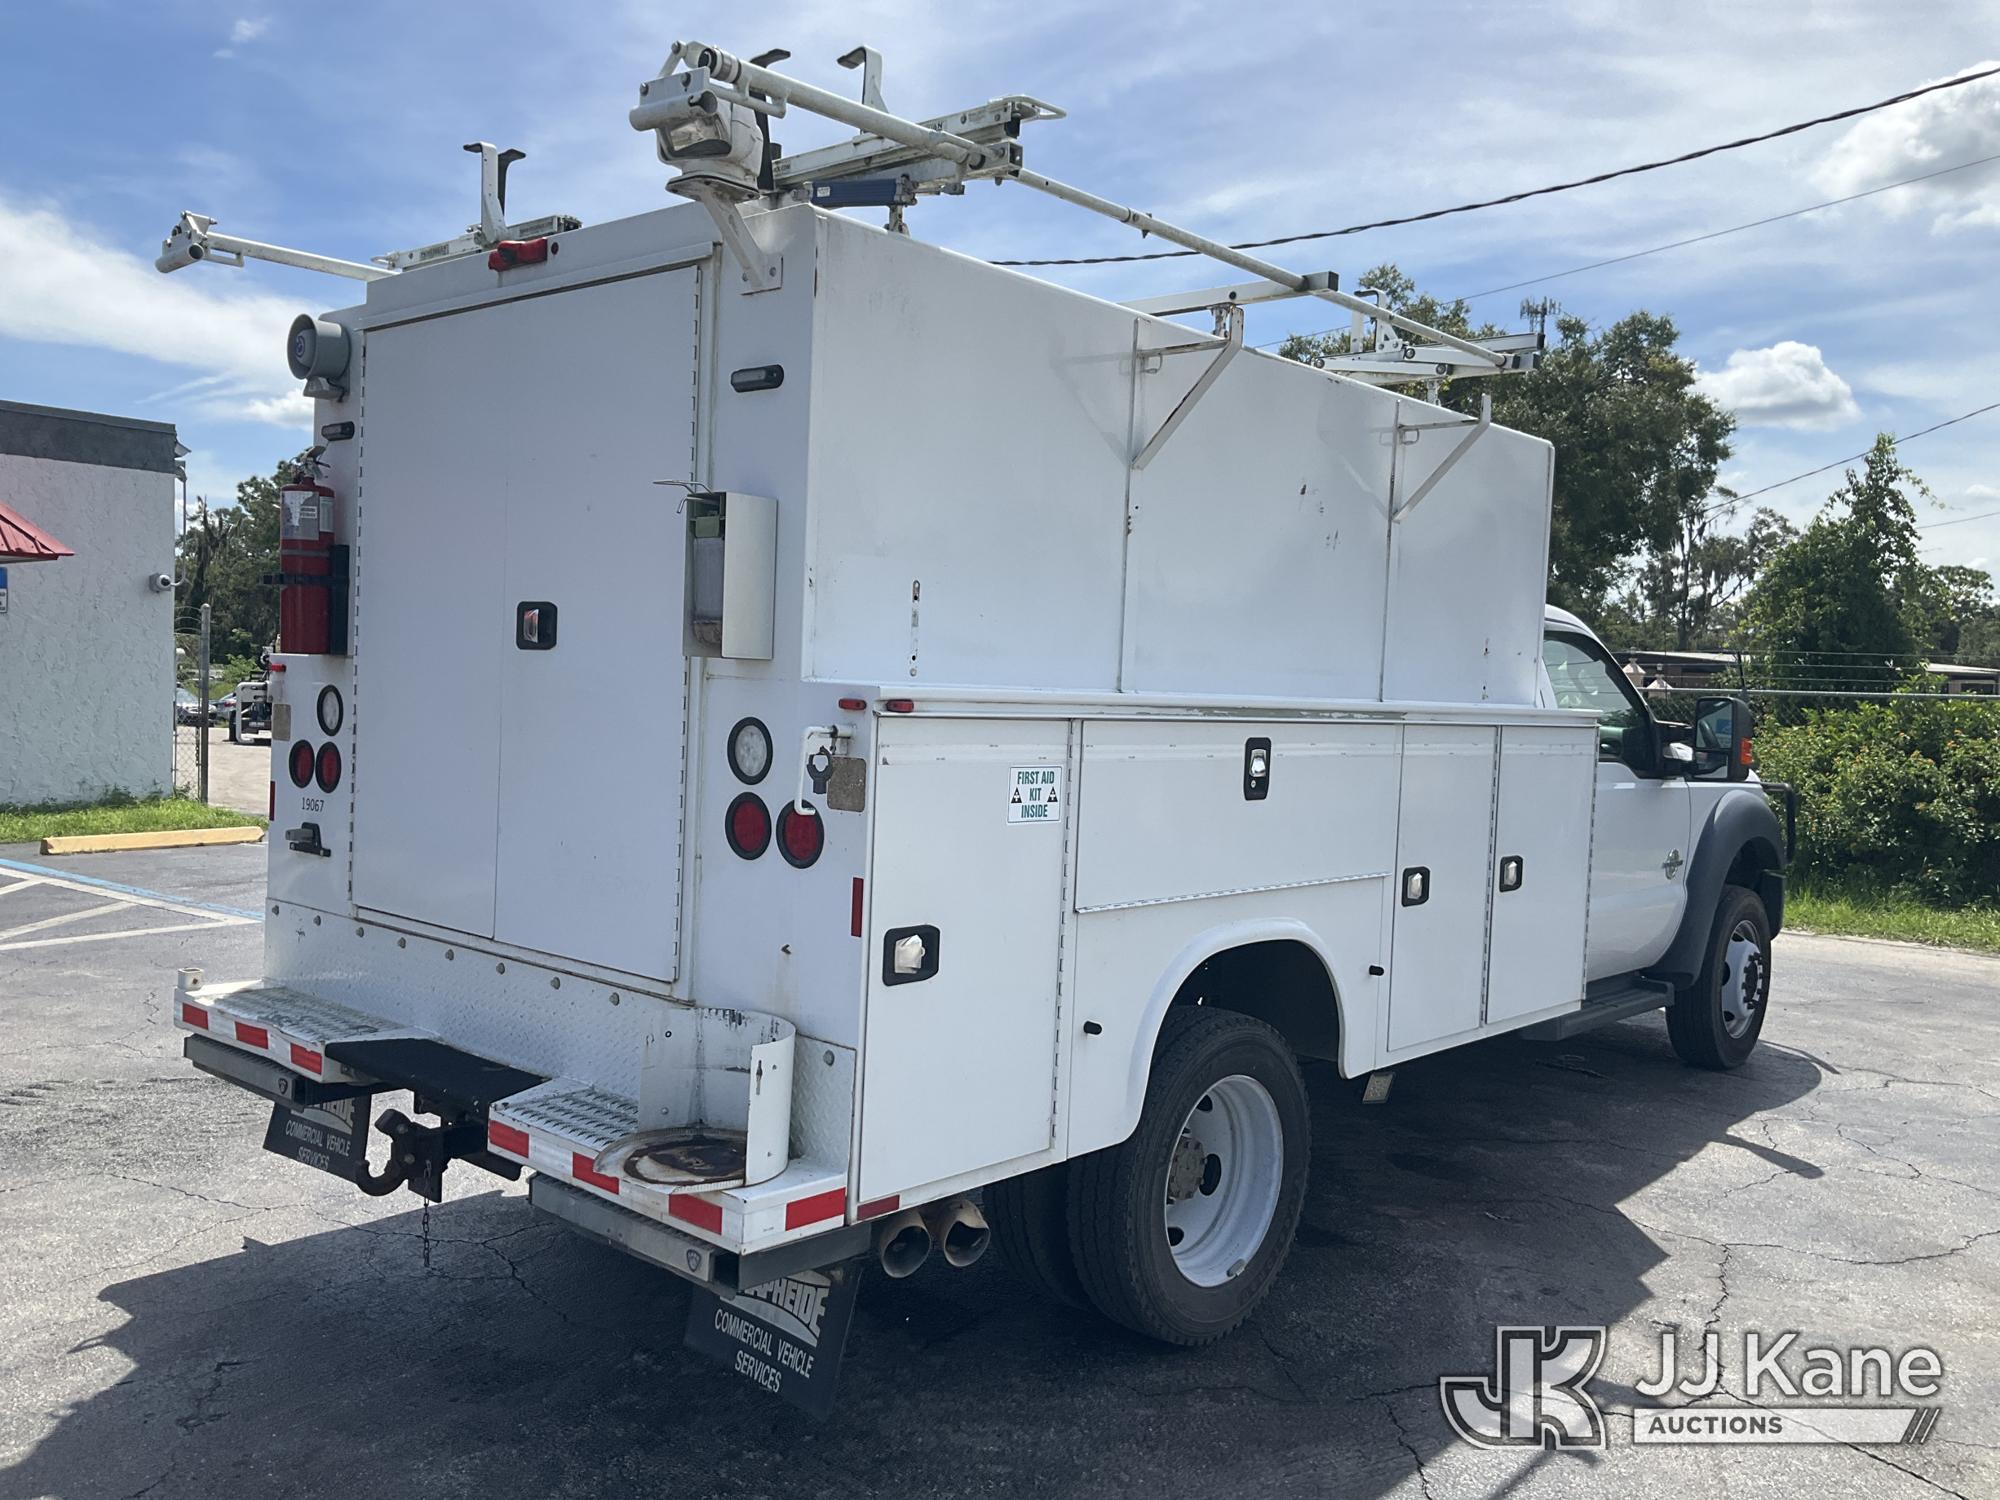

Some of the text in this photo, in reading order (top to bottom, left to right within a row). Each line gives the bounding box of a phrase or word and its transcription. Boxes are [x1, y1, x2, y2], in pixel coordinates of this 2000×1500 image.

[1017, 770, 1055, 785] FIRST AID
[1029, 787, 1042, 801] KIT
[301, 797, 325, 812] 19067
[1021, 804, 1048, 818] INSIDE
[285, 1119, 351, 1157] COMMERCIAL VEHICLE
[297, 1146, 330, 1170] SERVICES
[714, 1308, 815, 1379] COMMERCIAL VEHICLE
[734, 1349, 782, 1393] SERVICES
